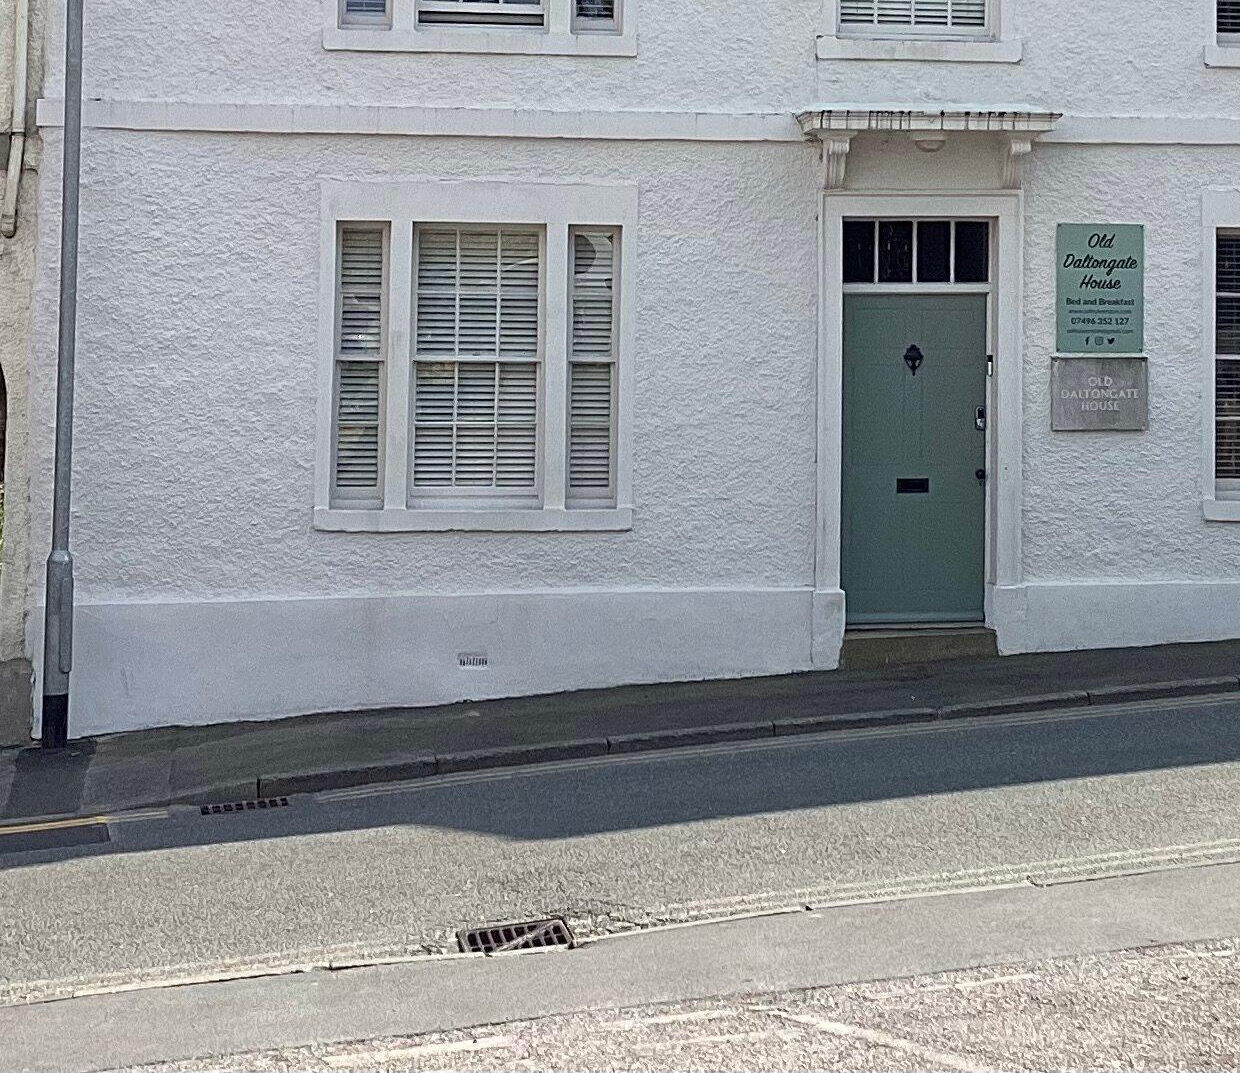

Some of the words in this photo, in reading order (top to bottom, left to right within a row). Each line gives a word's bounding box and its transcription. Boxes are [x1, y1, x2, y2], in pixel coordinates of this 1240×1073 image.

[1088, 233, 1115, 248] Old
[1063, 254, 1138, 276] Daltongate
[1080, 274, 1121, 289] House
[1088, 376, 1113, 387] OLD
[1061, 389, 1139, 399] DALTONGATE
[1081, 401, 1120, 411] HOUSE
